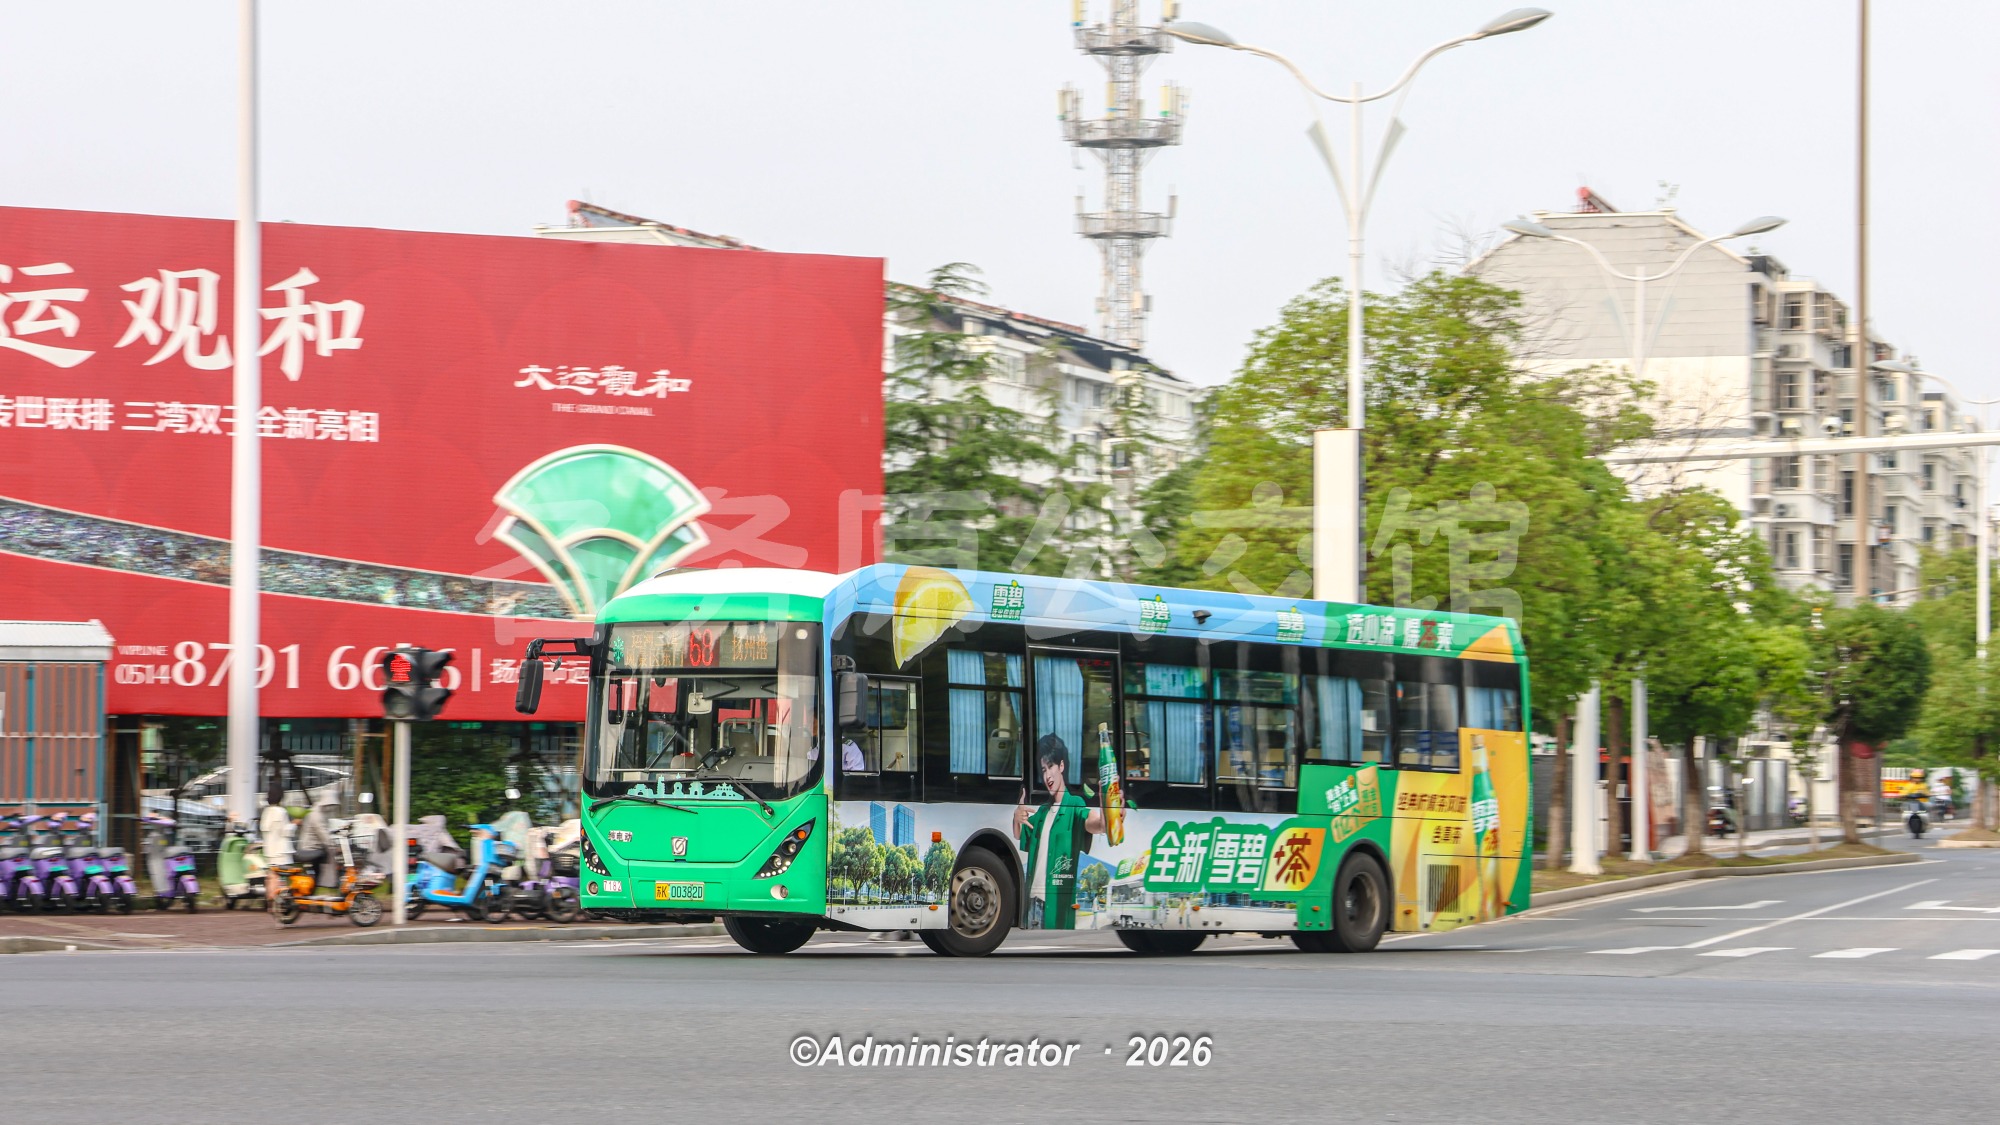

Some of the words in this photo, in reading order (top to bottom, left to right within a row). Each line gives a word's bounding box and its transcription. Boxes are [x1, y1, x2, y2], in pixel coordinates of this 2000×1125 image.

[0, 262, 365, 382] 运观和
[993, 584, 1024, 608] 雪碧
[1139, 600, 1169, 620] 雪碧
[1346, 613, 1396, 646] 透心凉
[689, 628, 713, 666] 68
[114, 663, 171, 685] 0514
[171, 641, 300, 689] 8791
[327, 645, 461, 690] 666
[489, 658, 591, 684] 扬市运
